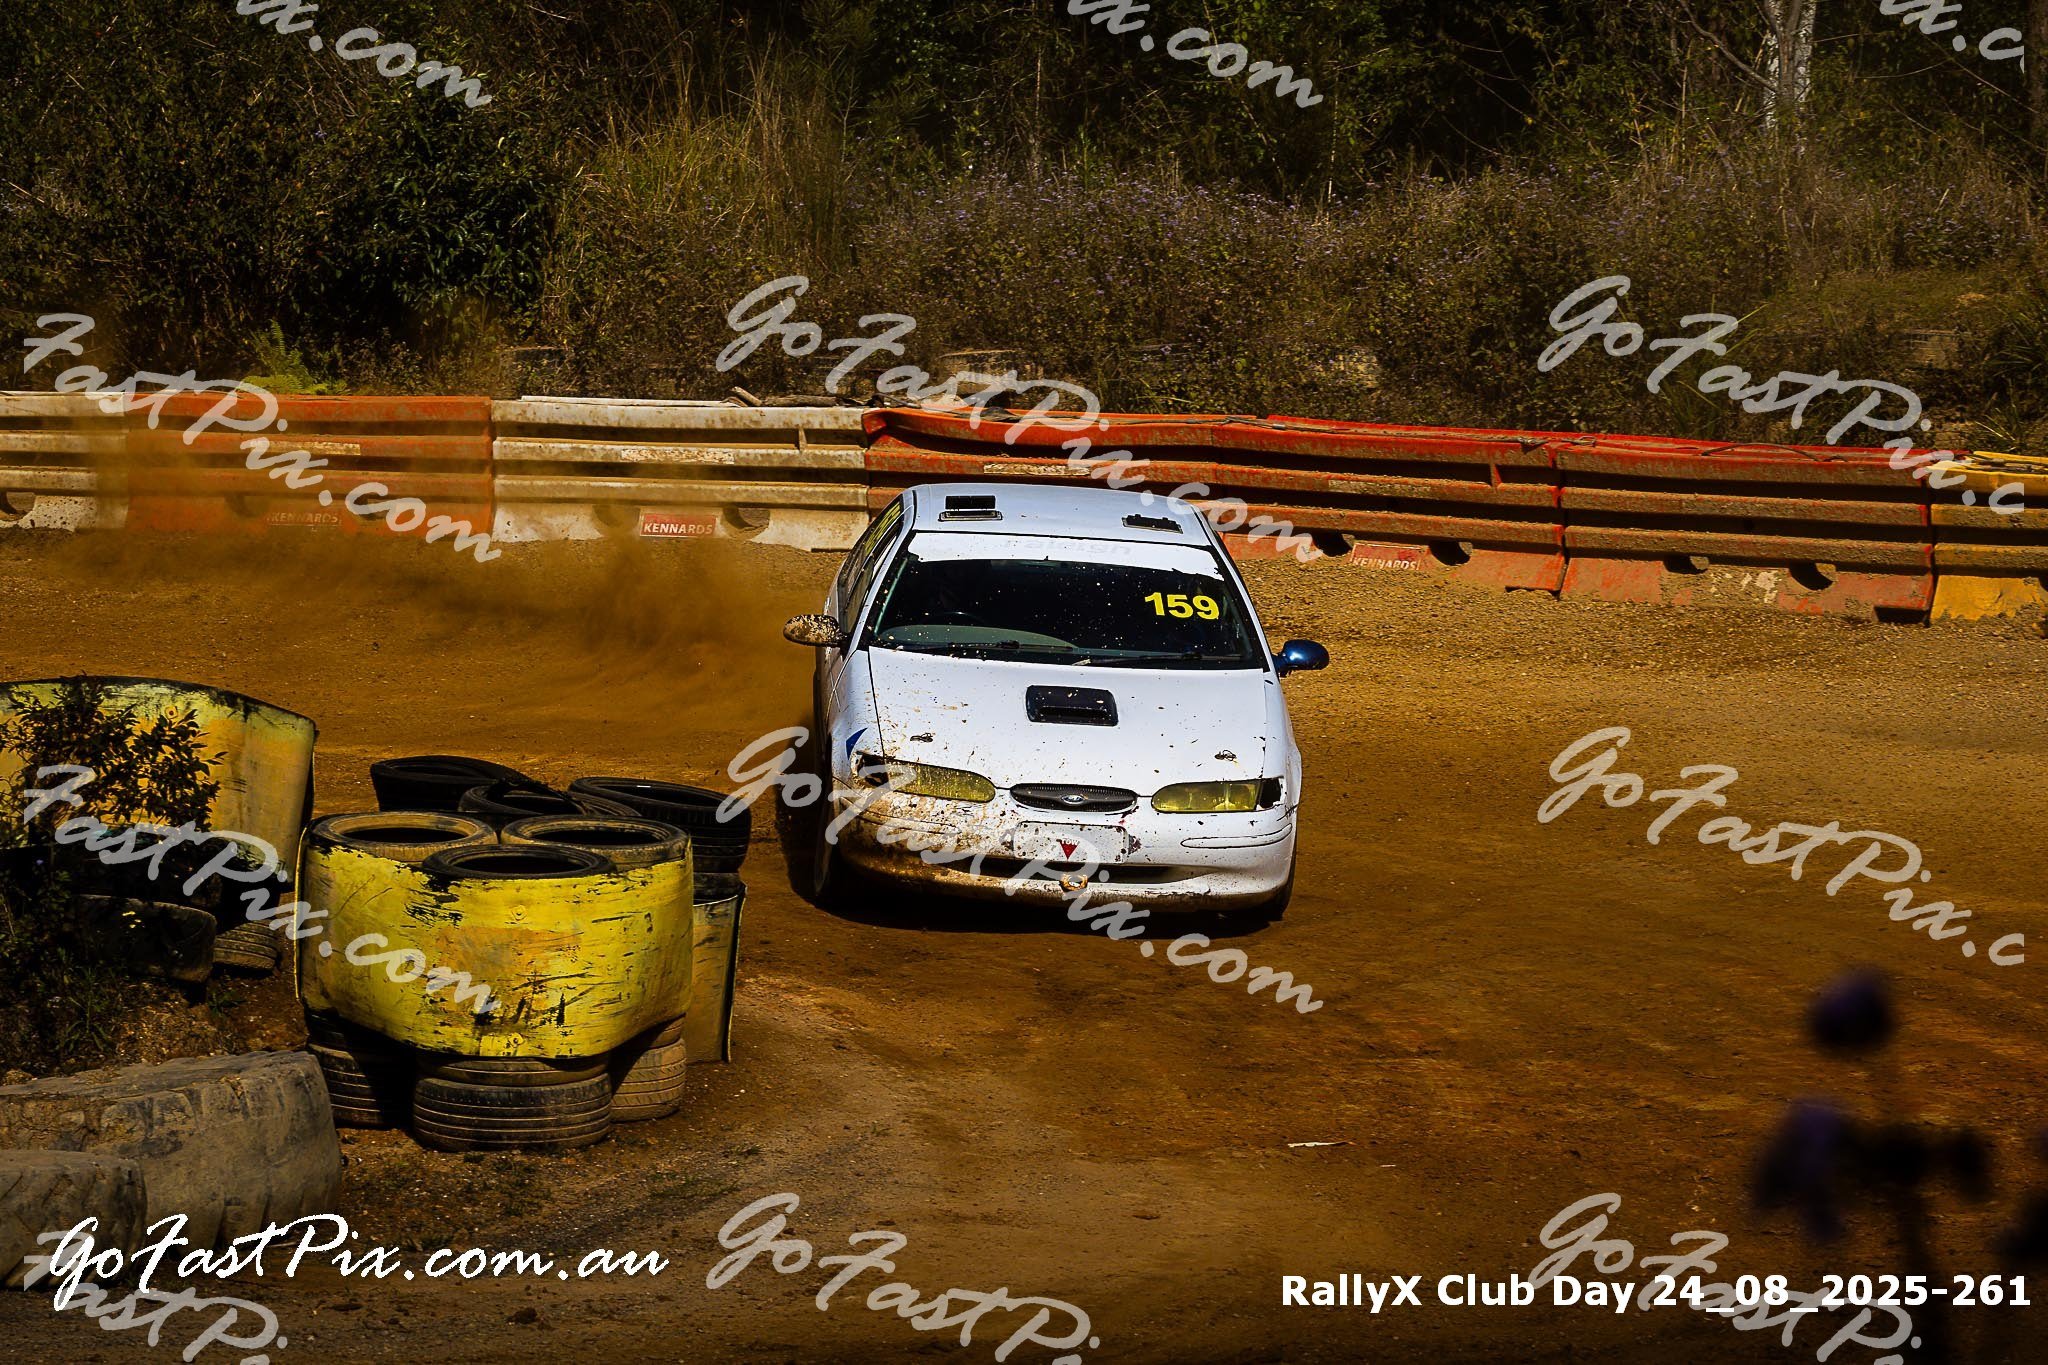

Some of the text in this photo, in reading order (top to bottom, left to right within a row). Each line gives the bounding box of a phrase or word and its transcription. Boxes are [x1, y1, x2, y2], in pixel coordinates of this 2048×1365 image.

[643, 523, 713, 535] KENNARDS
[1352, 557, 1417, 570] KENNARDS
[1144, 592, 1220, 620] 159
